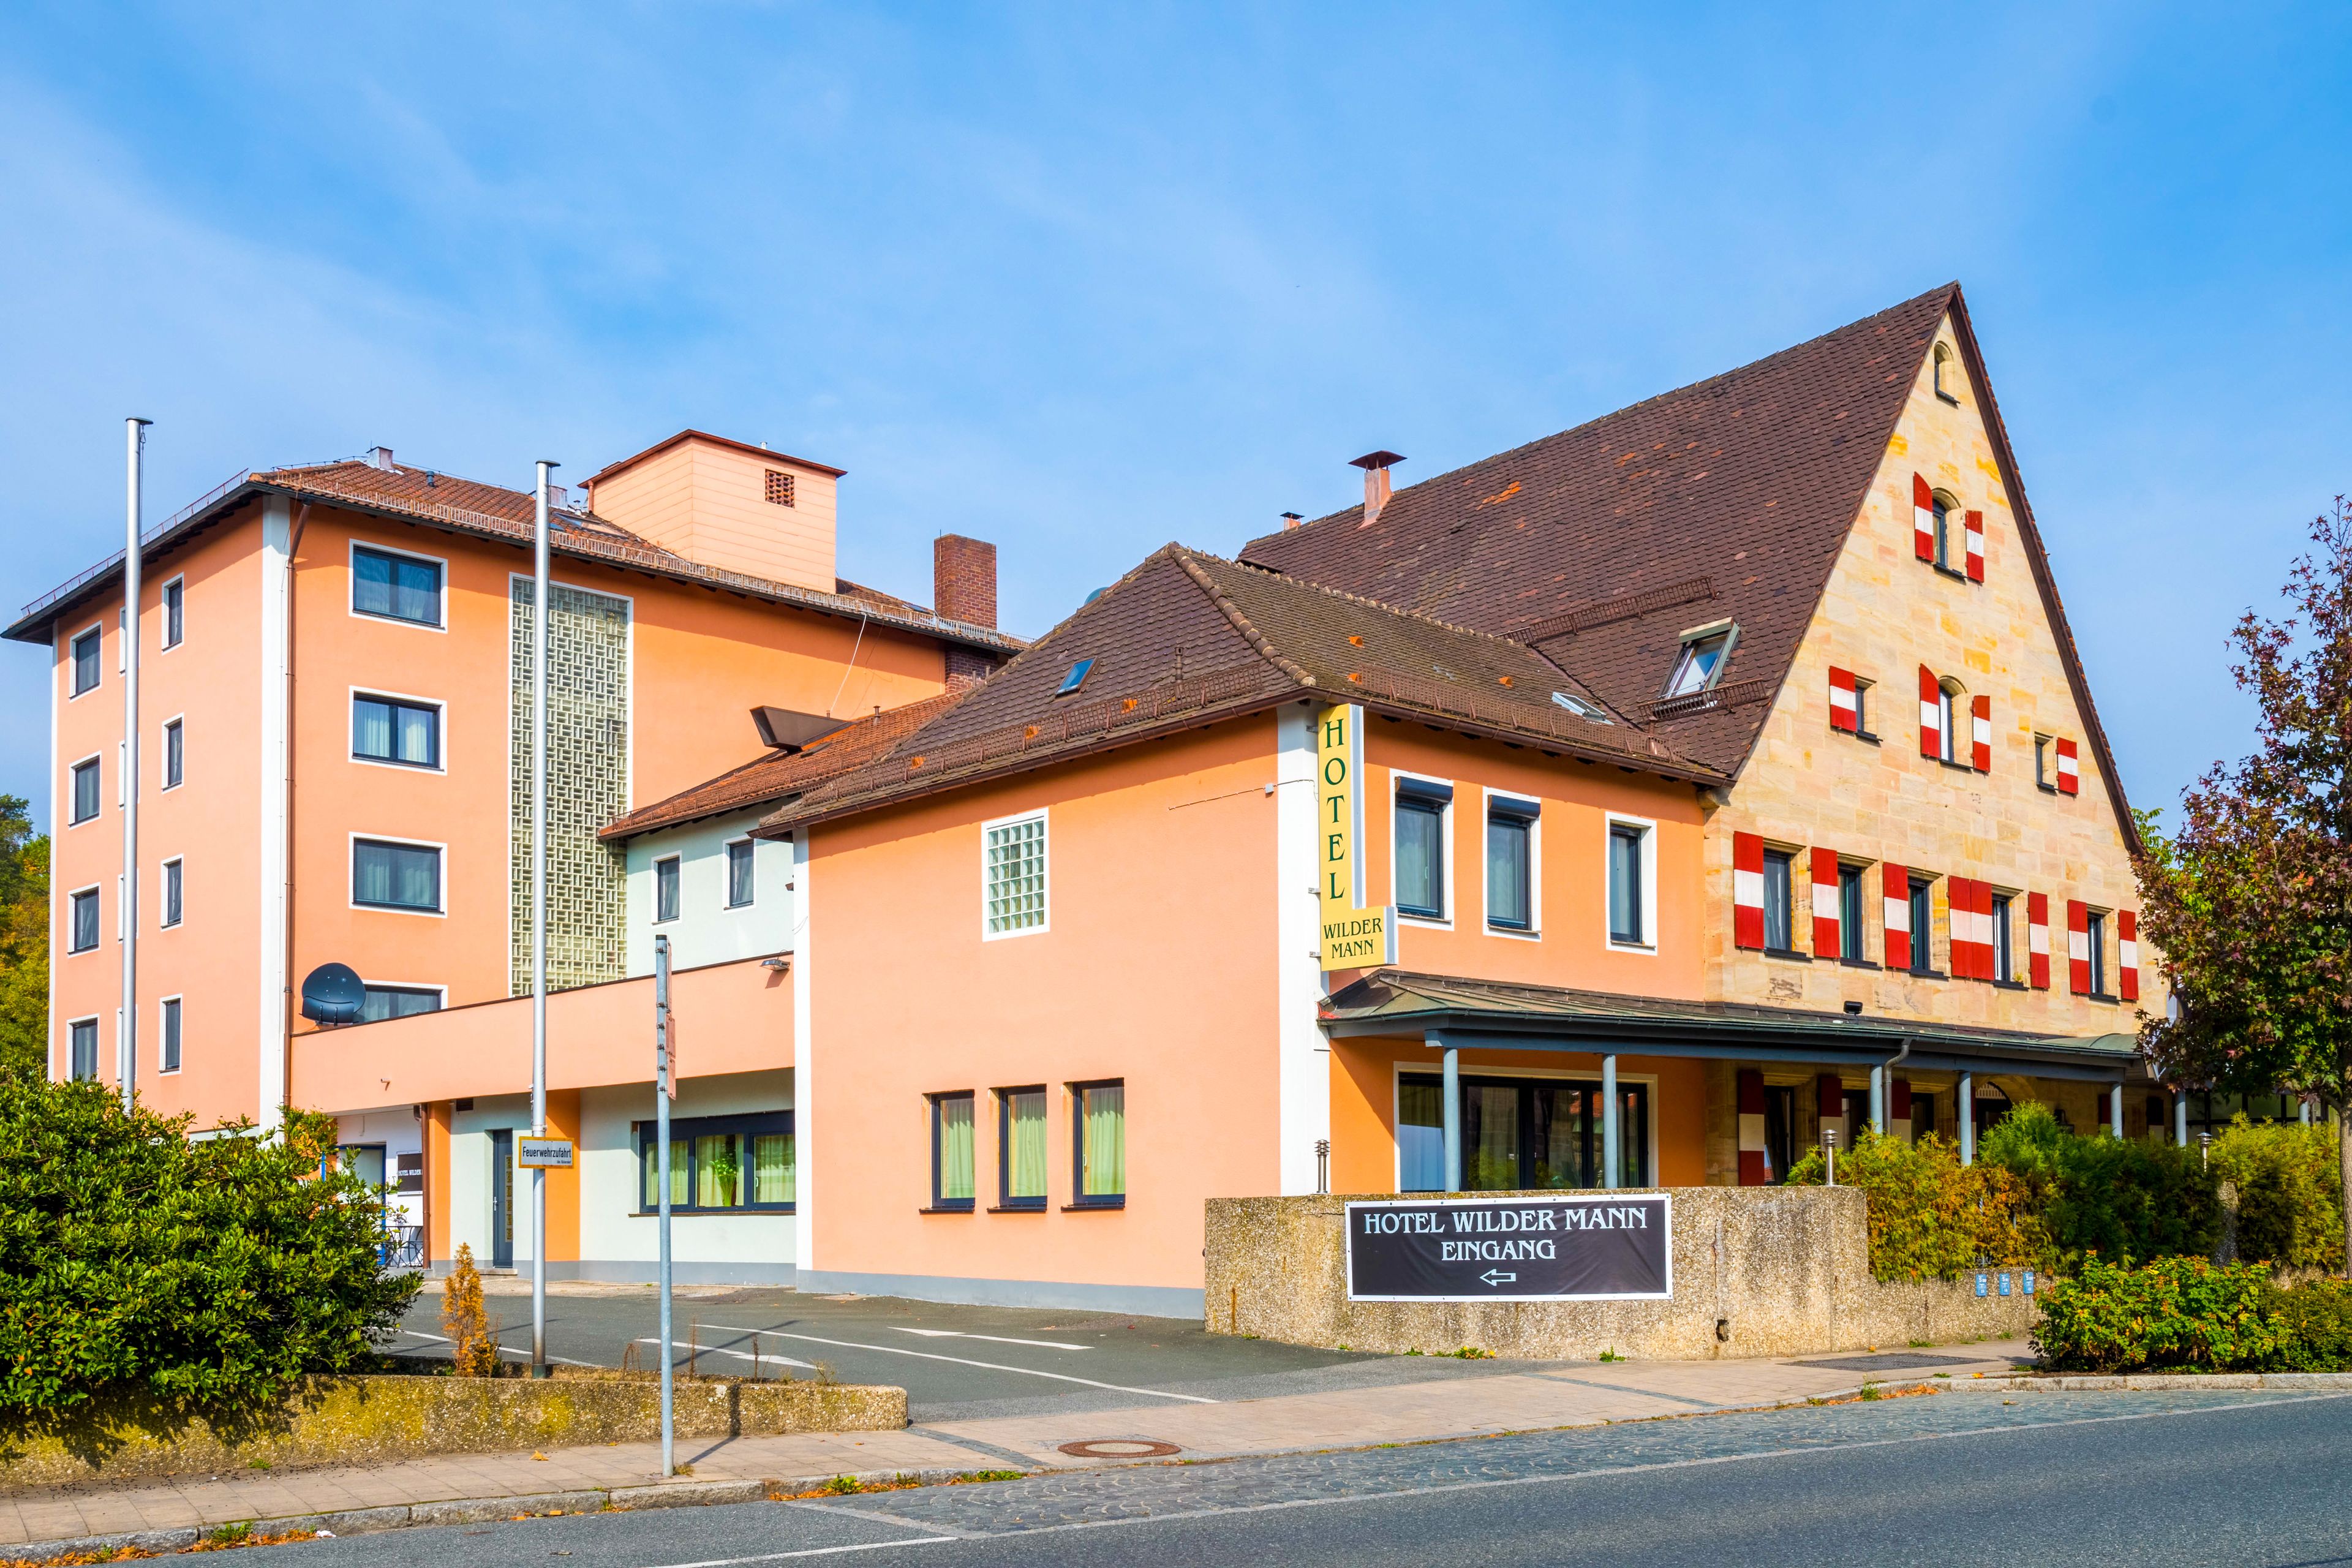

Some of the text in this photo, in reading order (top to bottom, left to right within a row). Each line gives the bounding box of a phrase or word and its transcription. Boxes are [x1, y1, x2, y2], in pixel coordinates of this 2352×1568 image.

[1324, 718, 1346, 900] HOTEL
[1324, 918, 1382, 940] WILDER
[1331, 939, 1374, 959] MANN
[522, 1147, 571, 1158] Feuerwehrzufahrt
[1364, 1207, 1648, 1235] HOTEL WILDER MANN
[1441, 1239, 1556, 1261] EINGANG
